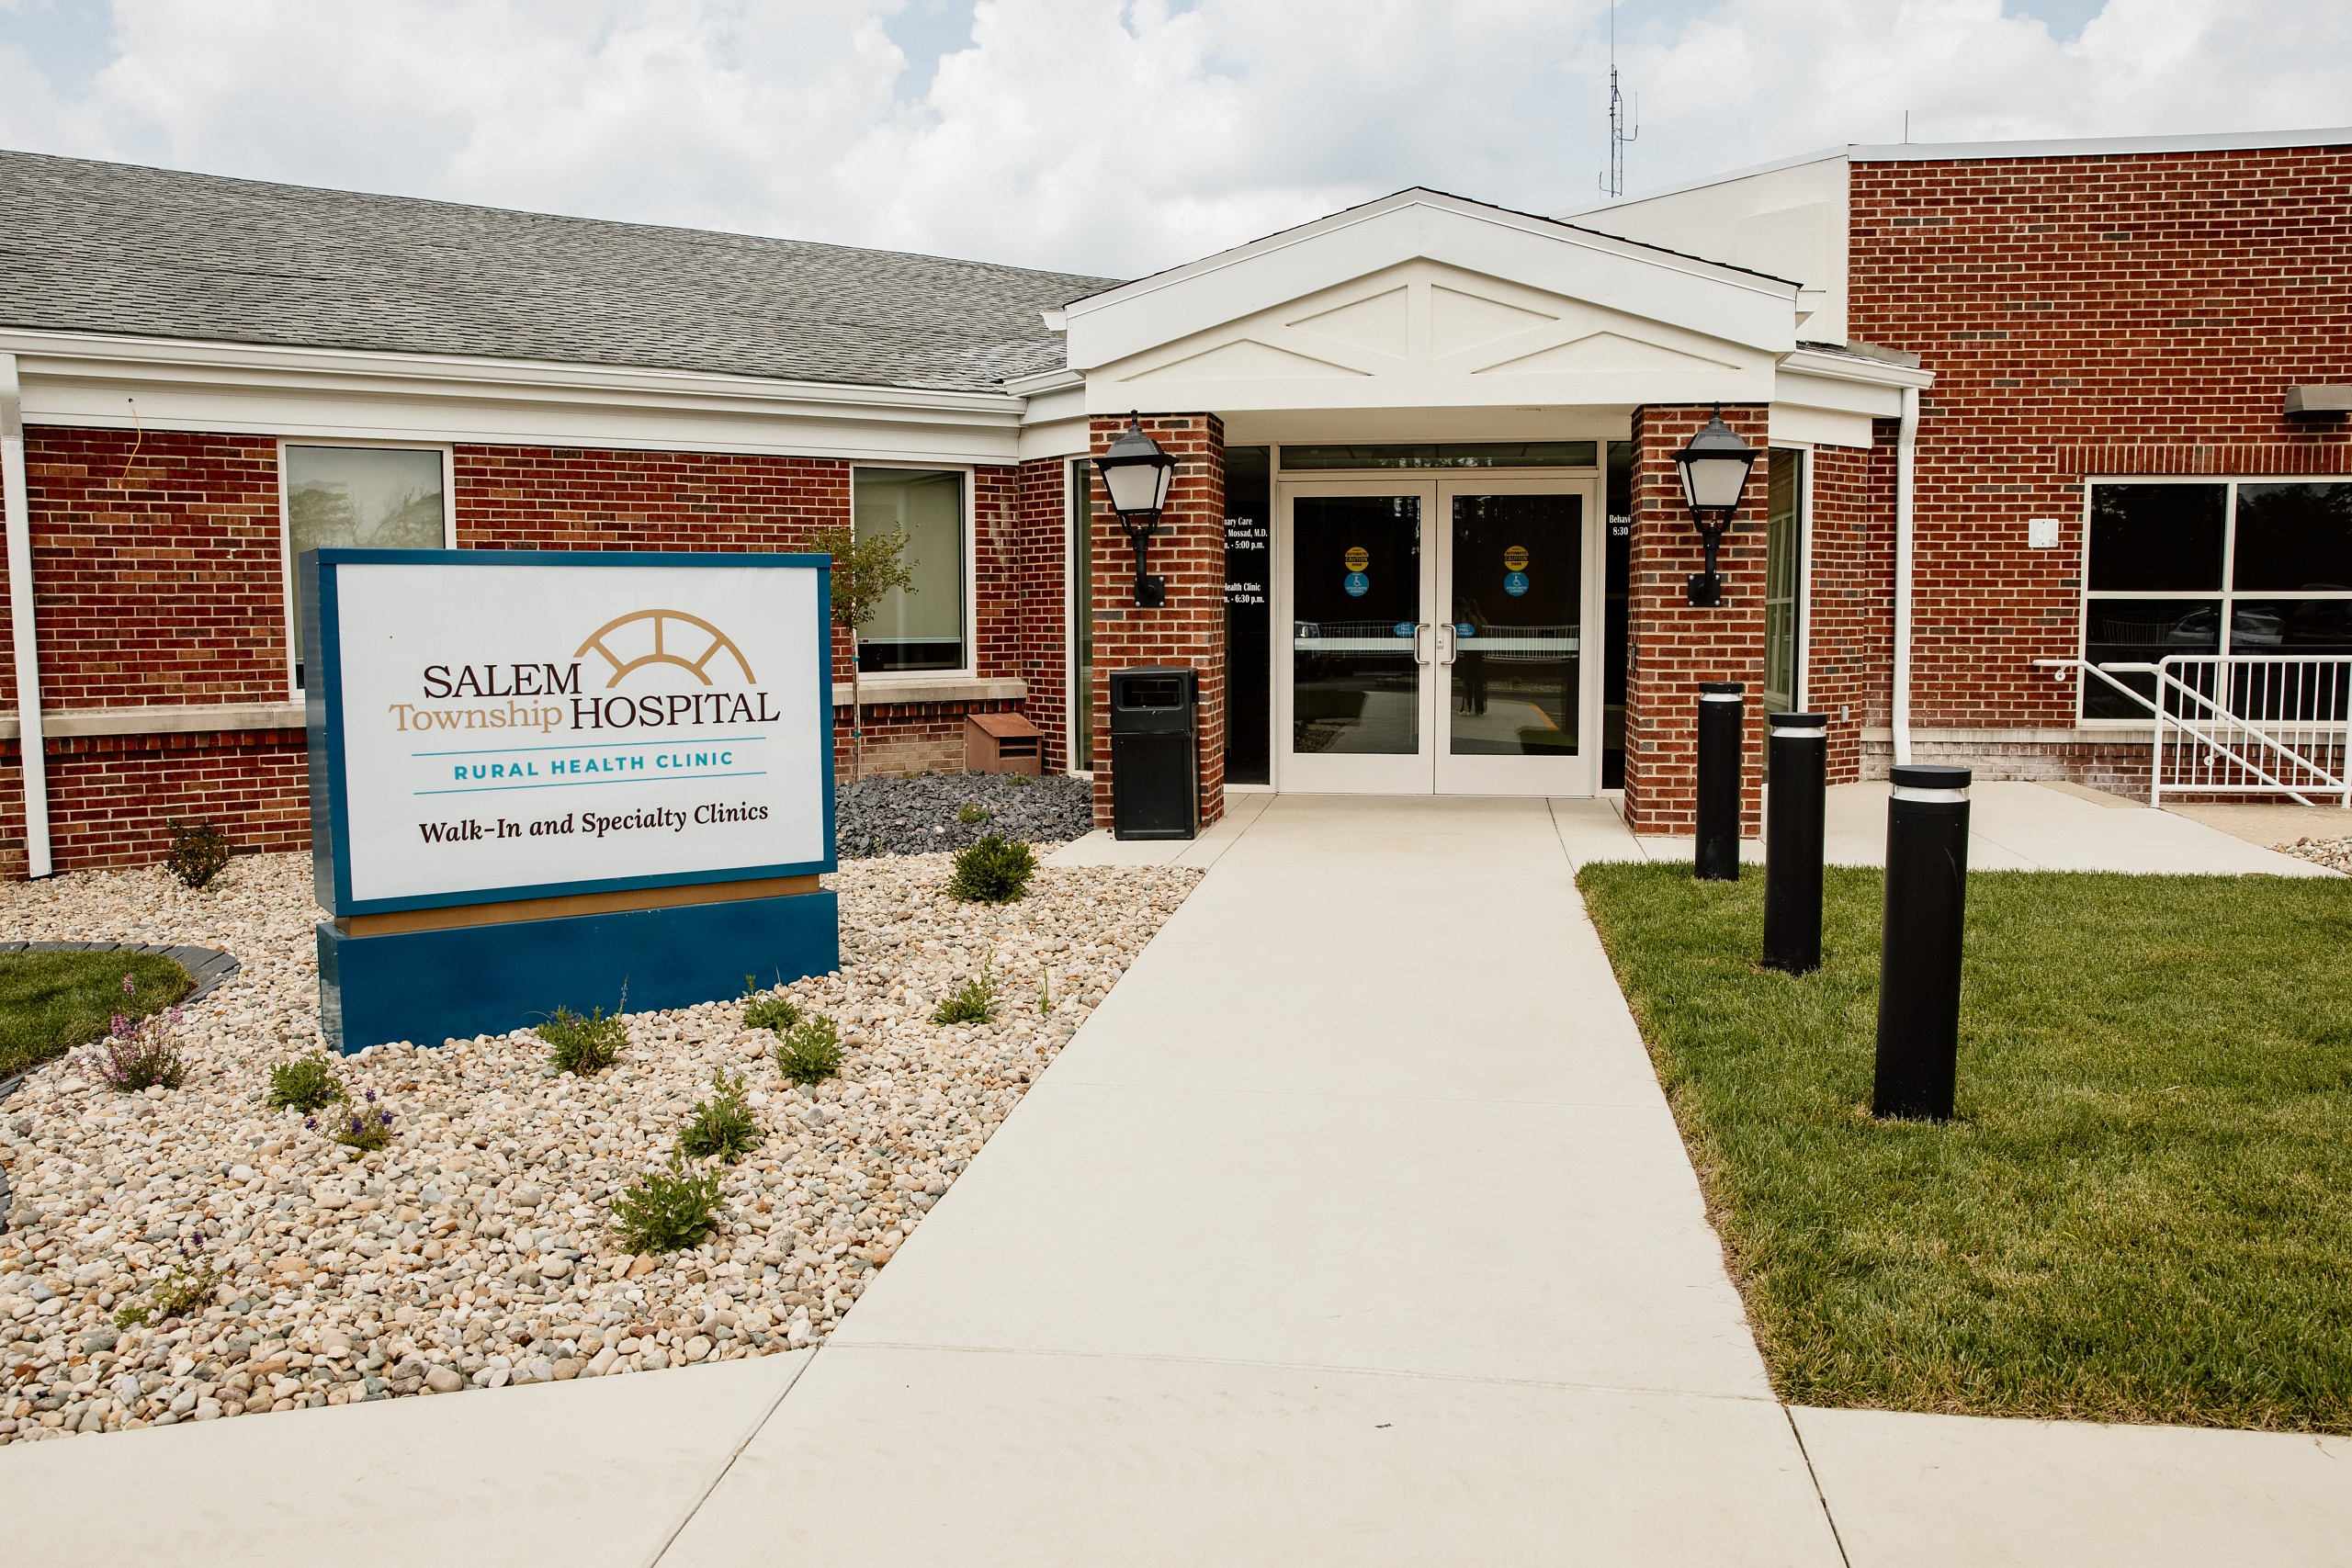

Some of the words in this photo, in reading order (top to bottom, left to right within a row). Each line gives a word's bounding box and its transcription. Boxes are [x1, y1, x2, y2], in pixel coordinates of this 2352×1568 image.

[1238, 517, 1252, 525] Care
[1227, 528, 1252, 538] Mossad,
[1254, 528, 1268, 537] M.D.
[1613, 526, 1628, 536] 8:30
[1235, 540, 1250, 549] 5:00
[1251, 542, 1265, 550] p.m.
[1243, 582, 1261, 592] Clinic
[1235, 594, 1250, 604] 6:30
[1251, 596, 1265, 604] p.m.
[424, 662, 582, 699] SALEM
[389, 700, 563, 734] Township
[569, 693, 782, 730] HOSPITAL
[454, 761, 539, 781] RURAL
[550, 756, 645, 775] HEALTH
[655, 750, 734, 769] CLINIC
[418, 818, 523, 844] Walk-In
[529, 812, 575, 837] and
[582, 806, 687, 840] Specialty
[694, 800, 768, 826] Clinics
